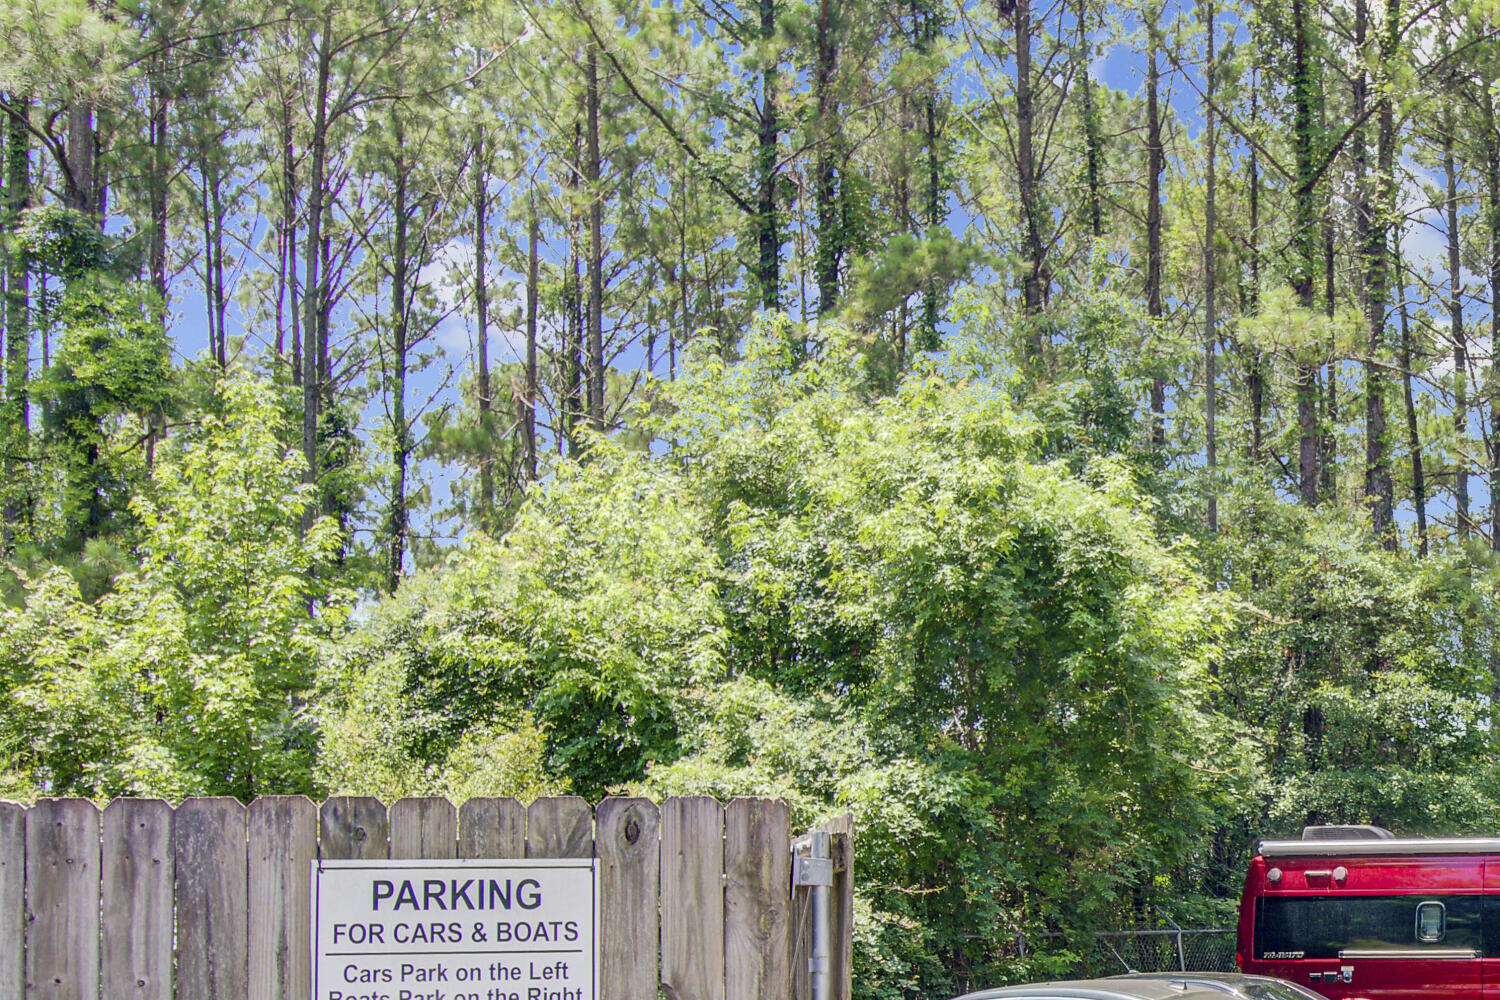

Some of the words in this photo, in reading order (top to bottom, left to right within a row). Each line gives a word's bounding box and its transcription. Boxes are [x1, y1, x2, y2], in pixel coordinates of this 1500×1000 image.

[373, 879, 541, 910] PARKING
[334, 924, 384, 944] FOR
[394, 923, 462, 943] CARS
[472, 922, 487, 942] &
[497, 921, 578, 942] BOATS
[344, 965, 392, 983] Cars
[402, 964, 448, 982] Park
[456, 968, 481, 981] on
[489, 963, 521, 980] the
[530, 962, 568, 980] Left
